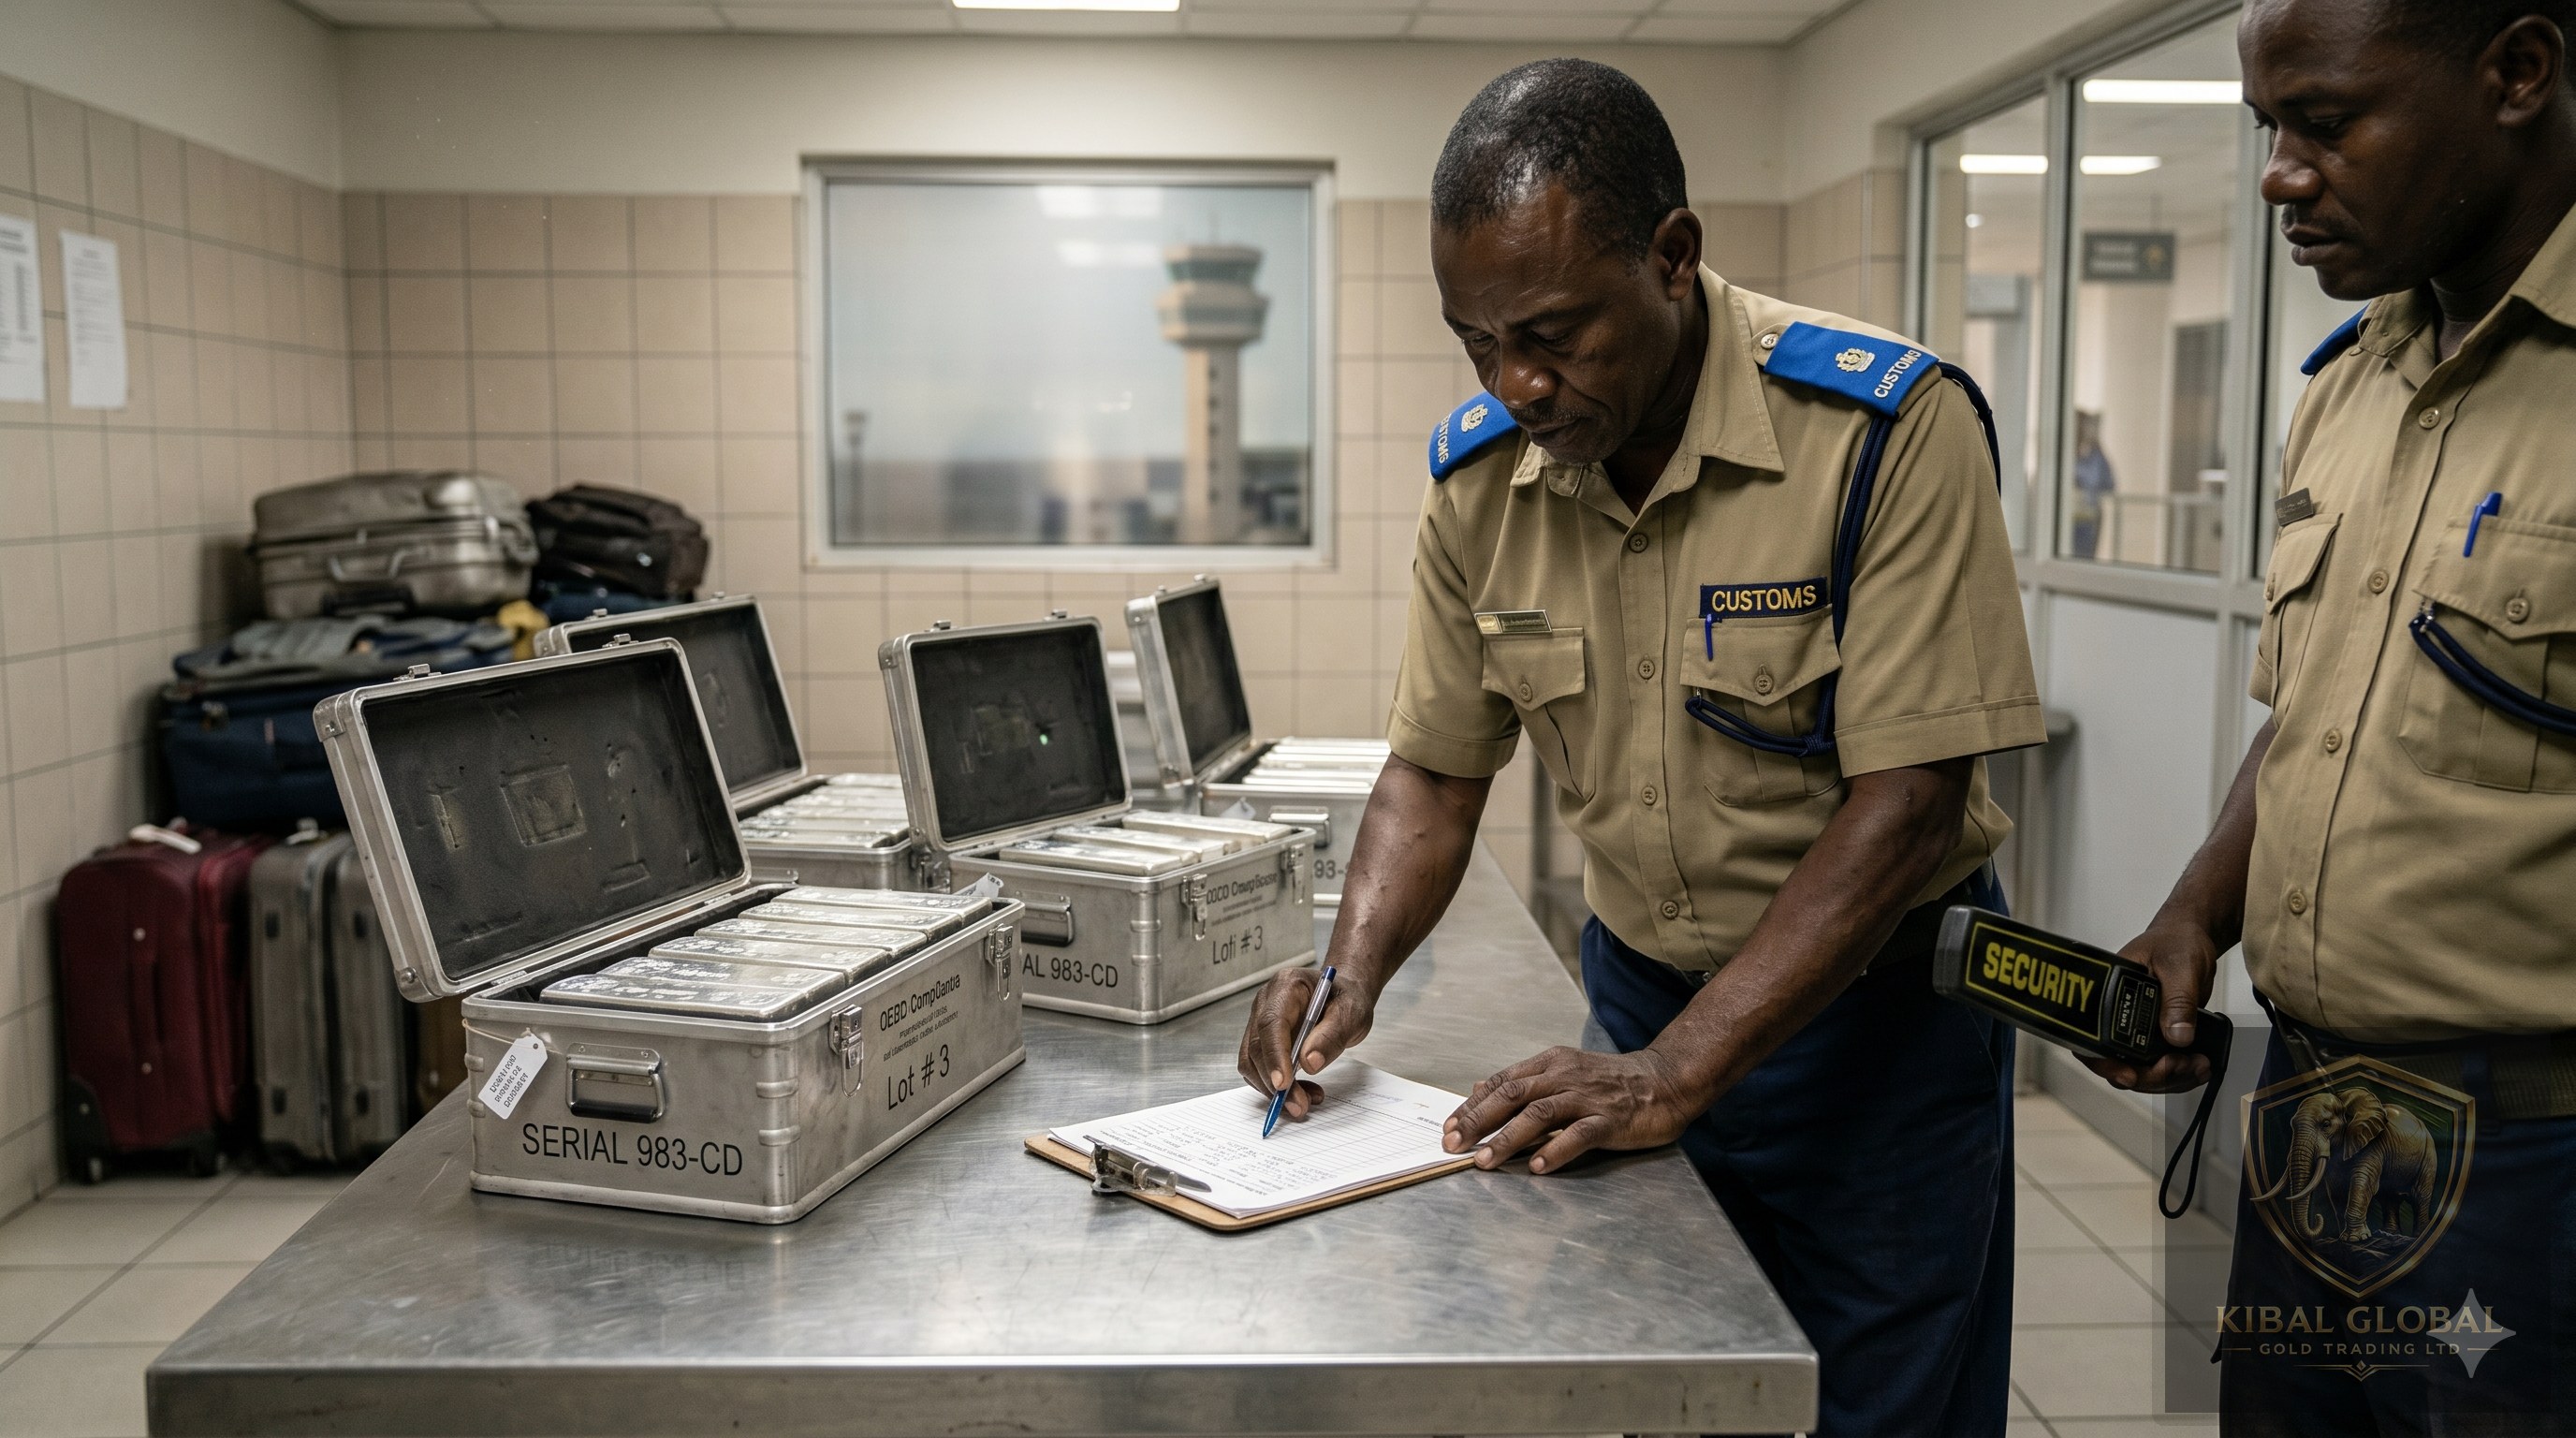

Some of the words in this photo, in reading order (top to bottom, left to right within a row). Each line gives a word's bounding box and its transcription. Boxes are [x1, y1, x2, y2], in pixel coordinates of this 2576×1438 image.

[1874, 349, 1922, 398] CUSTOMS
[1711, 585, 1817, 613] CUSTOMS
[1254, 925, 1263, 951] 3
[1050, 957, 1119, 989] 983-CD
[1983, 941, 2095, 1013] SECURITY
[888, 1064, 915, 1111] Lot
[920, 1051, 935, 1089] #
[940, 1044, 950, 1078] 3
[521, 1123, 628, 1166] SERIAL
[637, 1134, 743, 1177] 983-CD
